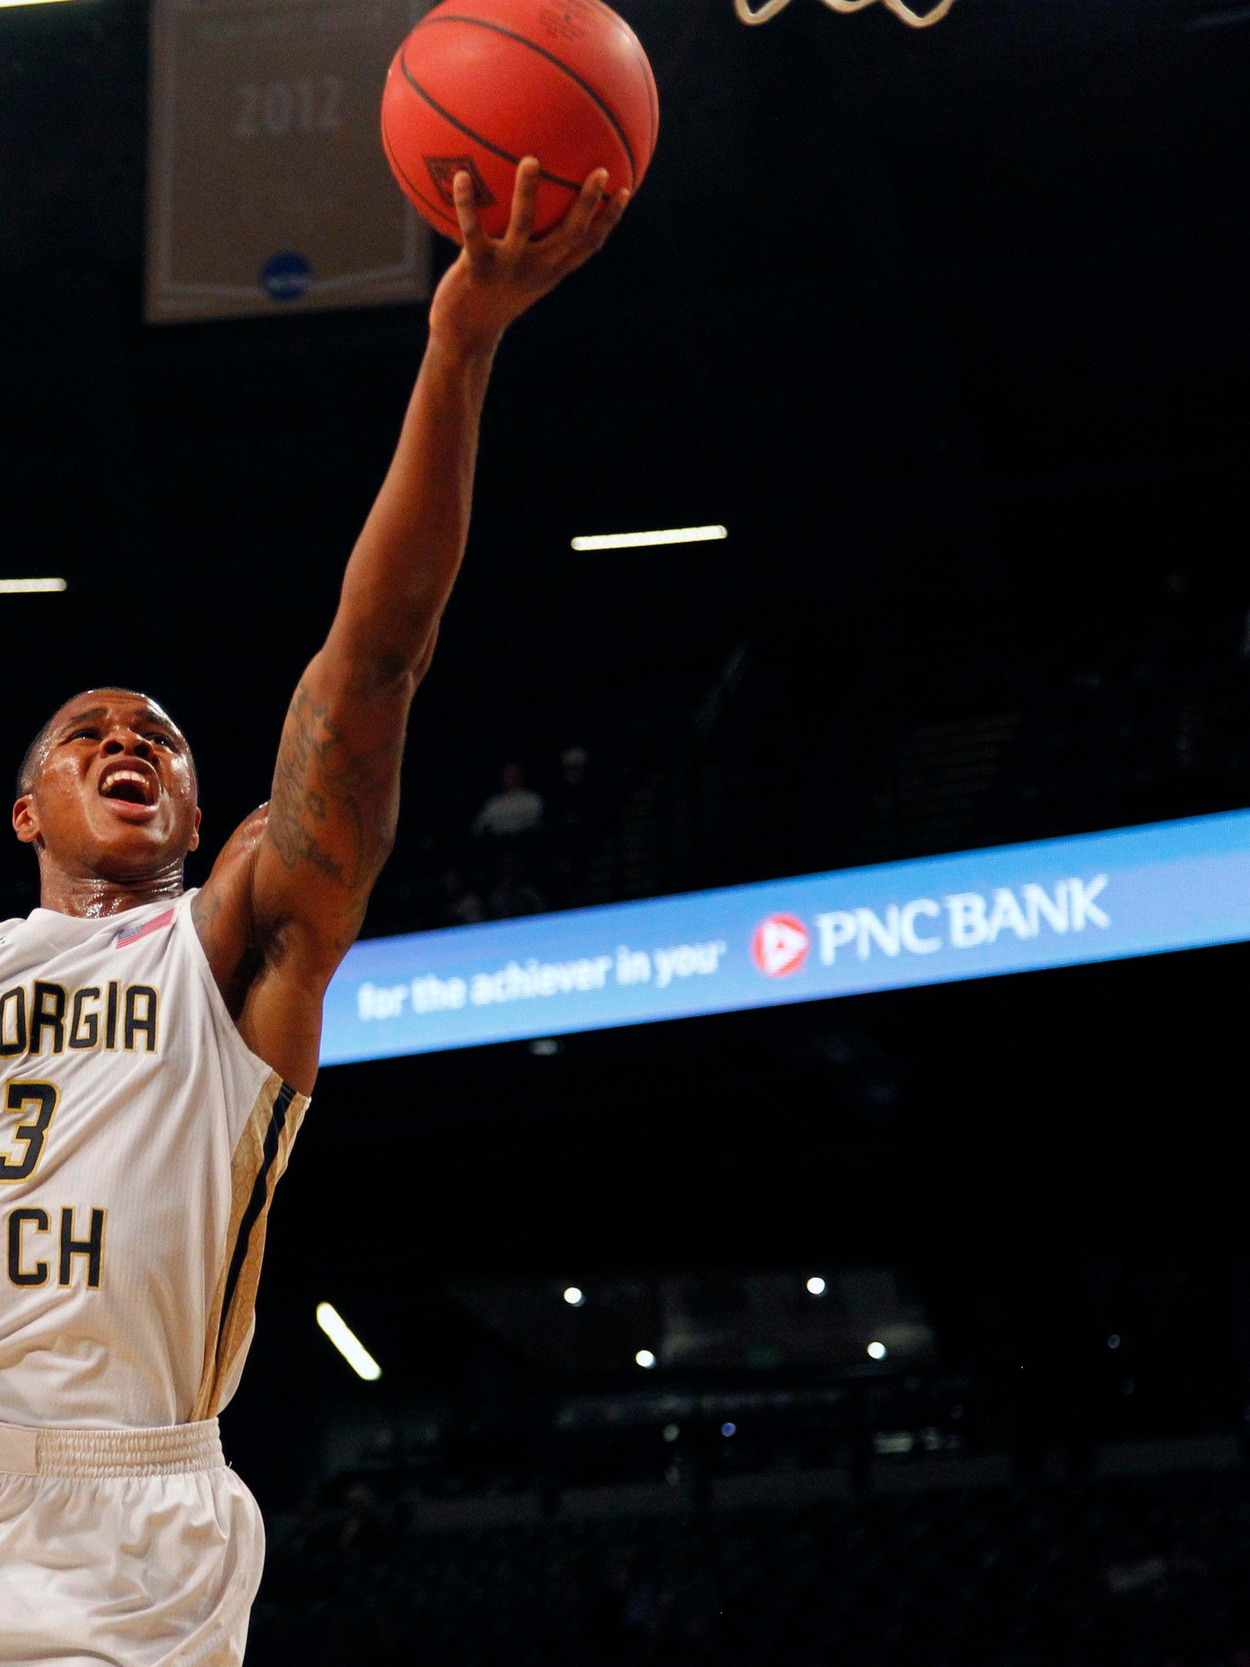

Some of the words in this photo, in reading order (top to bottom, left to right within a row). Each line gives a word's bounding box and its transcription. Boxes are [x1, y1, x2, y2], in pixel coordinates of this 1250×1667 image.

[234, 75, 344, 138] 2012
[815, 898, 942, 966] PNC
[944, 872, 1111, 948] BANK
[357, 981, 409, 1021] for
[411, 973, 466, 1014] the
[469, 958, 613, 1005] achiever
[616, 944, 649, 985] in
